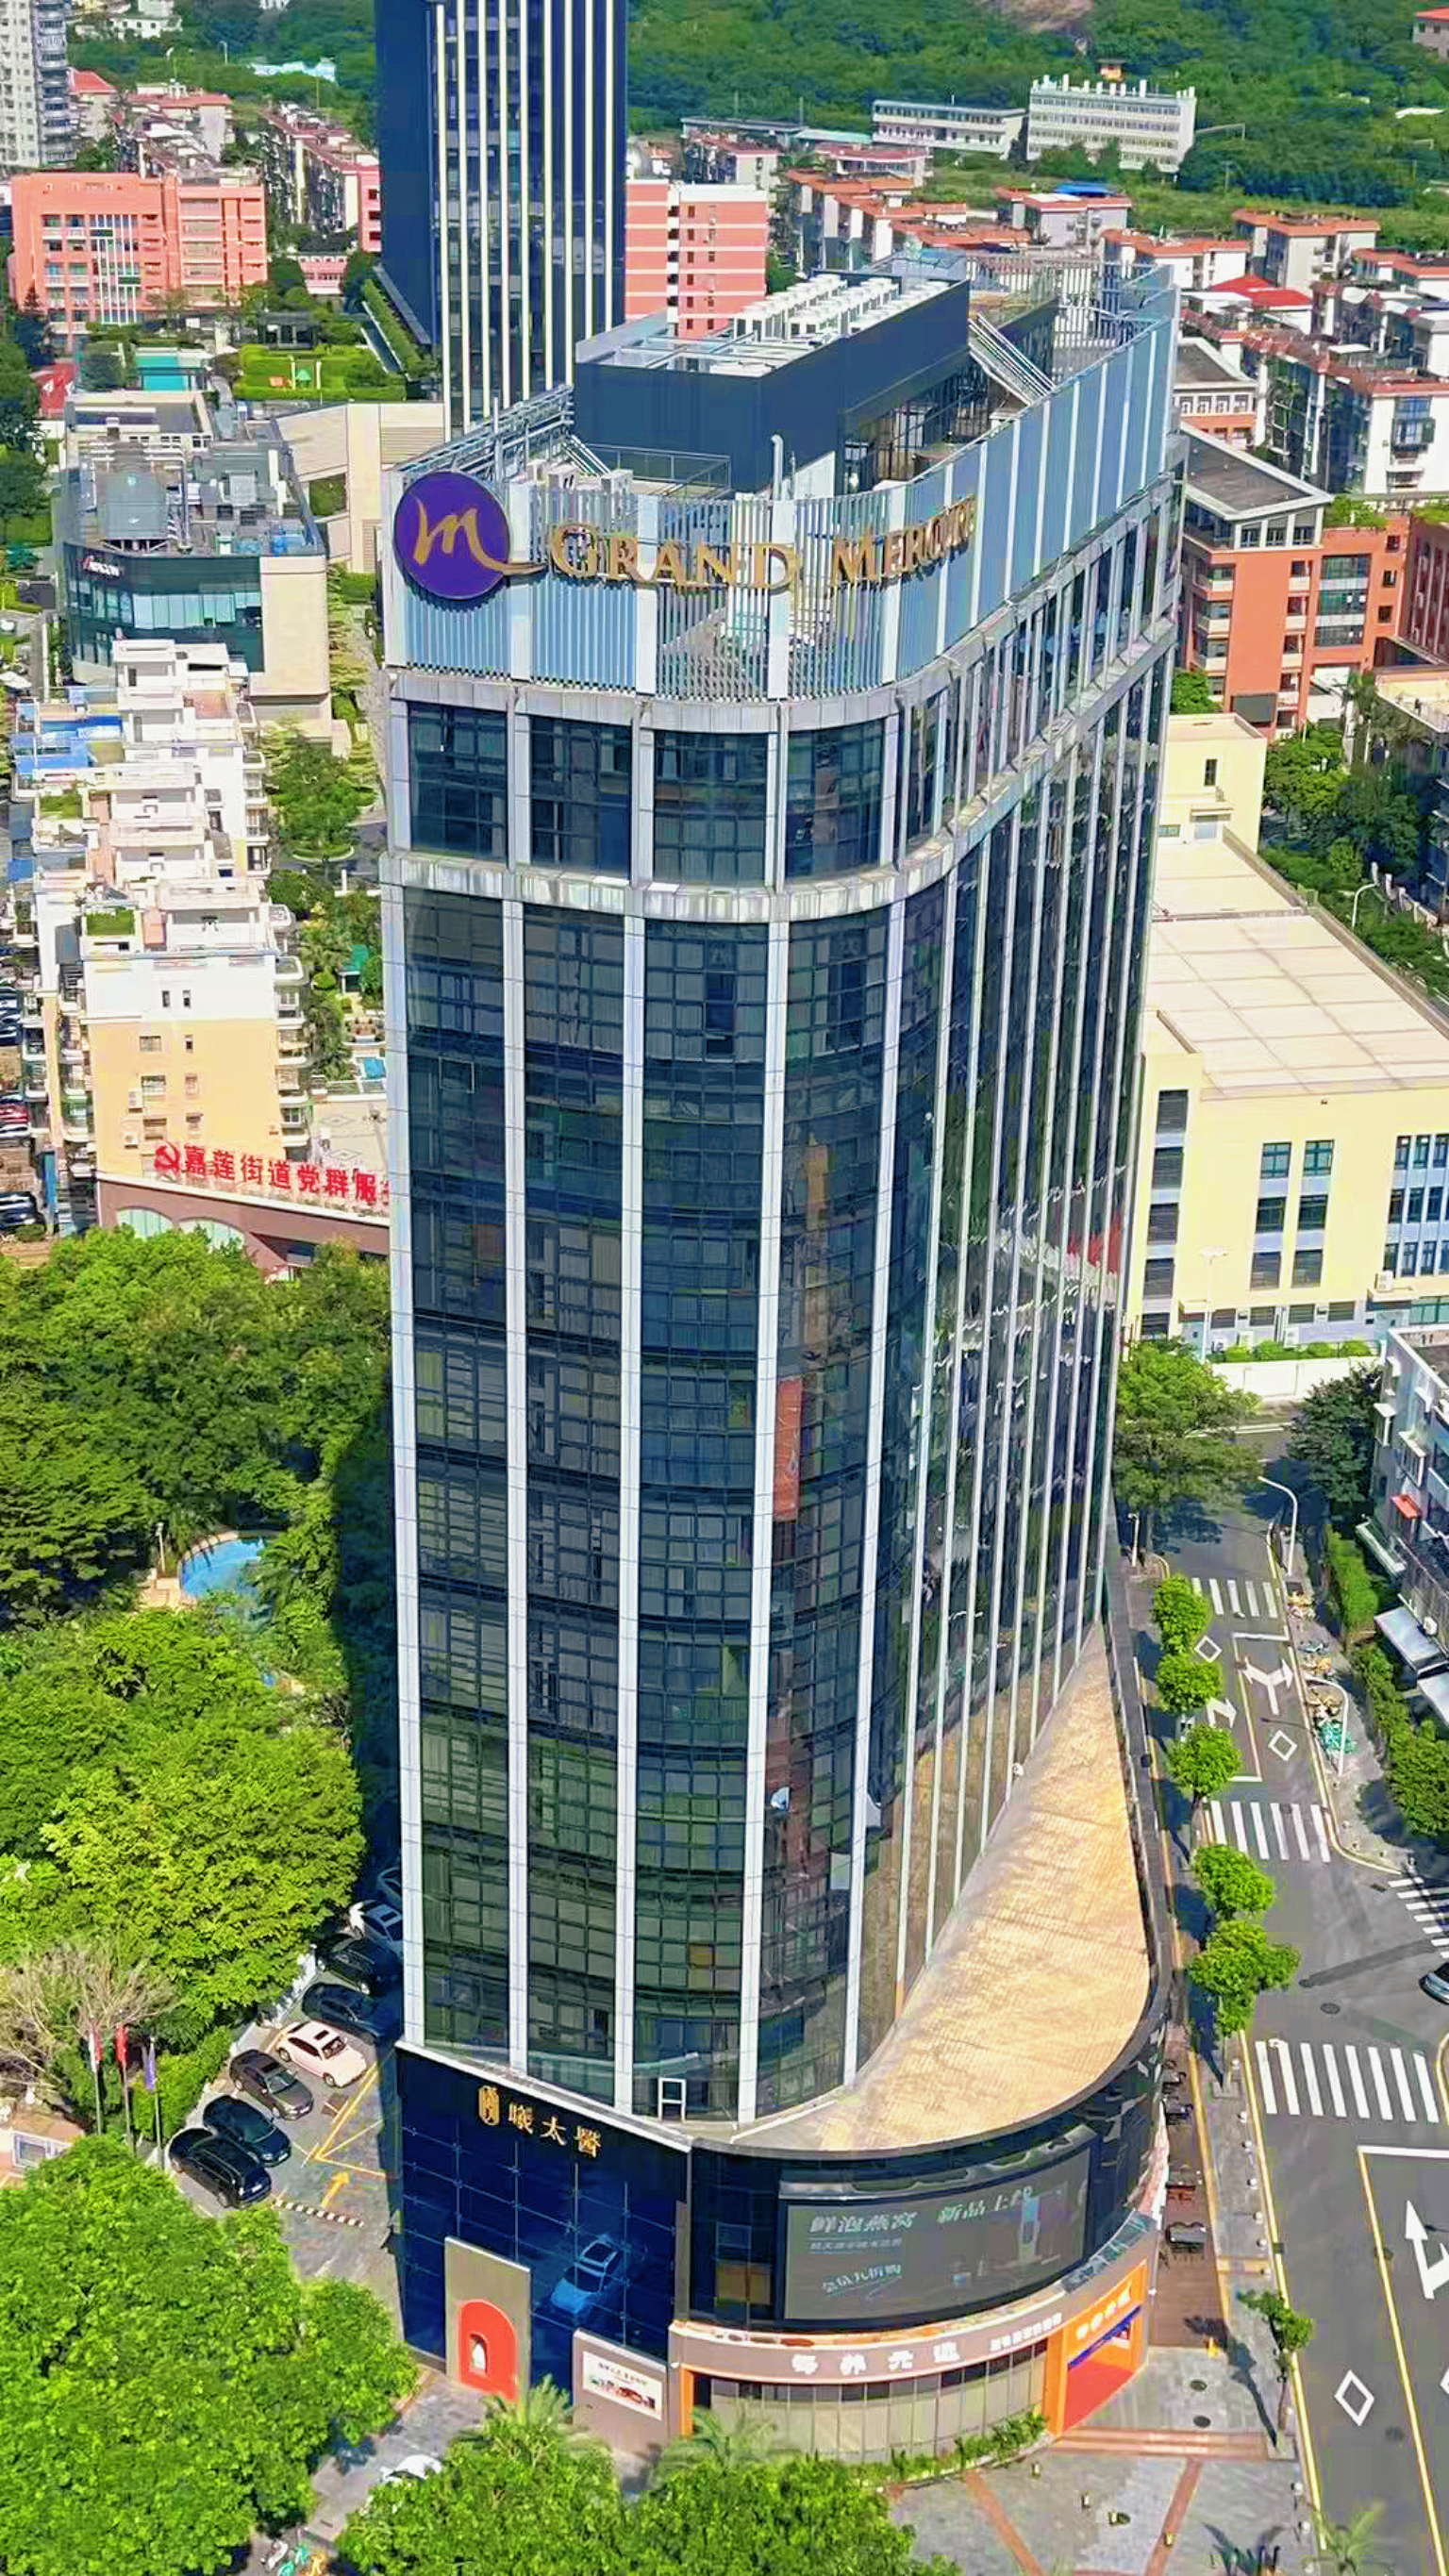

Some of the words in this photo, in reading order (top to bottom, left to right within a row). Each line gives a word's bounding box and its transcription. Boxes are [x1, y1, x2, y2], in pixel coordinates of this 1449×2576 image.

[548, 522, 803, 591] GRAND
[183, 1144, 389, 1205] 嘉莲街道党群服
